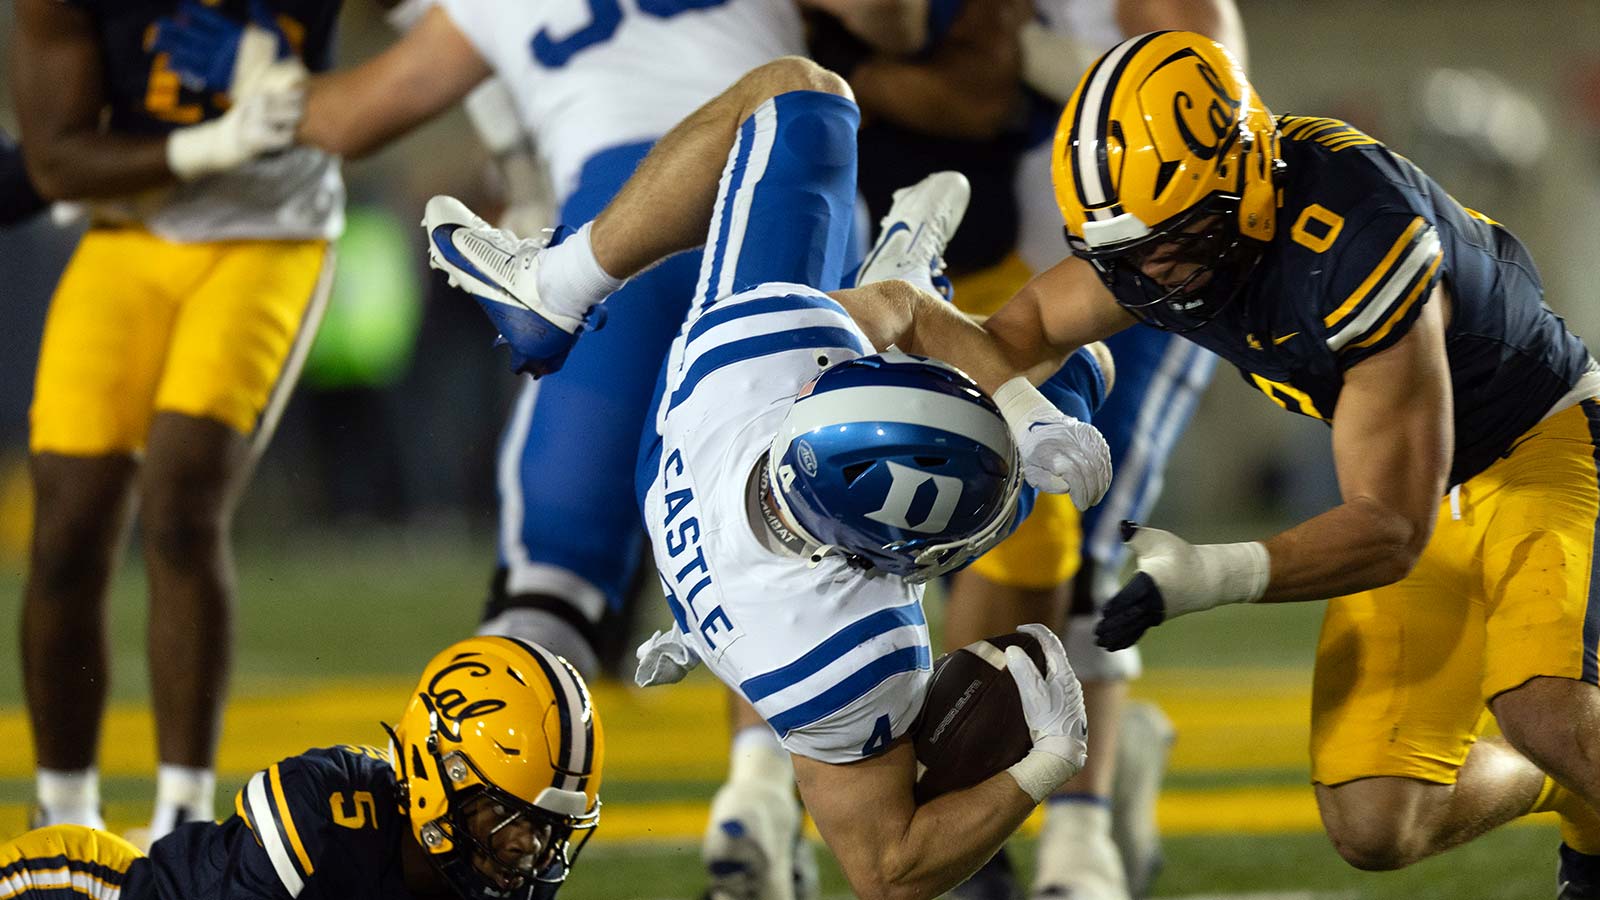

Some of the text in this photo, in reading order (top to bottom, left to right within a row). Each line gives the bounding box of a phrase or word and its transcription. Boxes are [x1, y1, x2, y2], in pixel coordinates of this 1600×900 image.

[1173, 62, 1243, 171] Cal
[1291, 204, 1345, 254] 0
[863, 460, 964, 534] D
[664, 447, 734, 651] CASTLE
[418, 661, 507, 742] Cal
[861, 712, 897, 757] 4
[328, 790, 378, 831] 5
